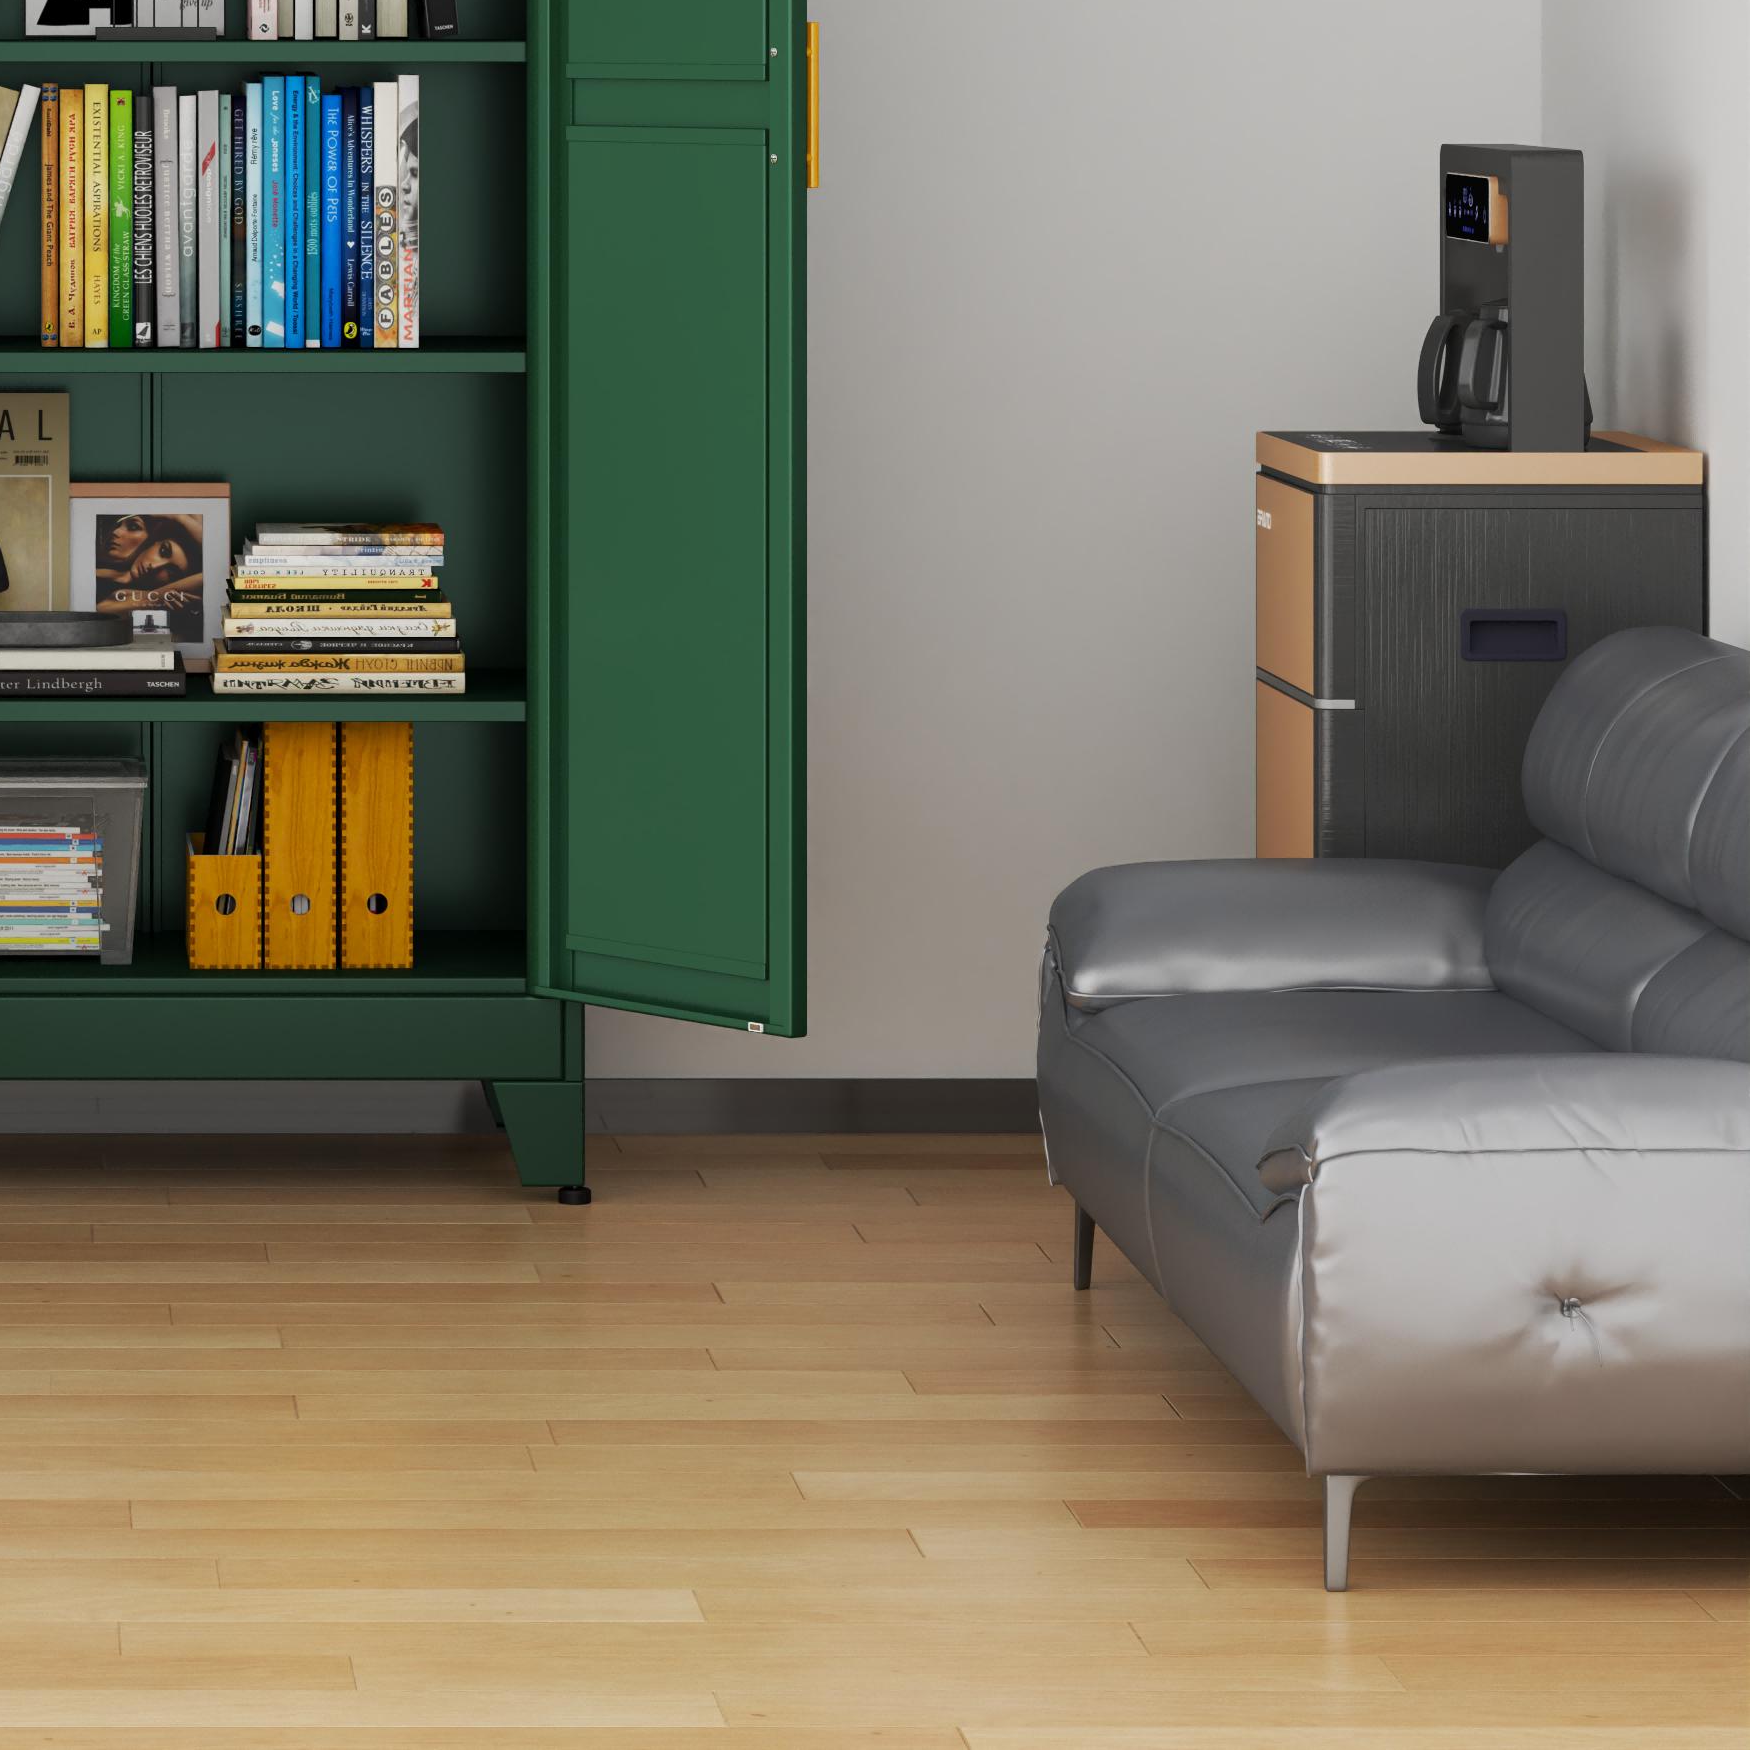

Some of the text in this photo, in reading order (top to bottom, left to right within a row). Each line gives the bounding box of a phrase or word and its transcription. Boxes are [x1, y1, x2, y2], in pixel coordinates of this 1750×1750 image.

[201, 1, 213, 10] up
[291, 90, 299, 112] Energy
[117, 125, 125, 148] KING
[272, 90, 280, 172] Love Joneses
[291, 119, 299, 129] the
[361, 105, 372, 174] WHISPERS
[134, 130, 152, 192] RETROVISEUR
[234, 108, 244, 225] GET HIRED BY GOD
[347, 139, 356, 179] Adventures
[92, 102, 102, 252] EXISTENTIAL ASPIRATIONS
[117, 164, 125, 191] VICKI
[291, 173, 299, 198] Choices
[347, 180, 356, 188] In
[361, 182, 369, 193] IN
[45, 163, 54, 267] James and The Peach
[291, 199, 299, 211] and
[347, 189, 356, 233] Wonderland
[361, 195, 369, 213] THE
[291, 212, 299, 246] Challenges
[307, 219, 318, 237] mots
[134, 233, 152, 266] CHIENS
[307, 238, 318, 256] 1500
[361, 220, 372, 280] SILENCE
[379, 189, 393, 327] FABLES
[93, 274, 102, 305] HAYES
[112, 265, 121, 308] KINGDOM
[122, 231, 130, 321] GREEN GLASS STRAW
[134, 268, 152, 284] LES
[291, 260, 299, 290] Changing
[347, 258, 356, 307] Lewis Carroll
[291, 290, 299, 309] World
[403, 247, 413, 341] MARTIAN
[115, 590, 185, 602] GUCCI
[26, 678, 103, 693] Lindbergh
